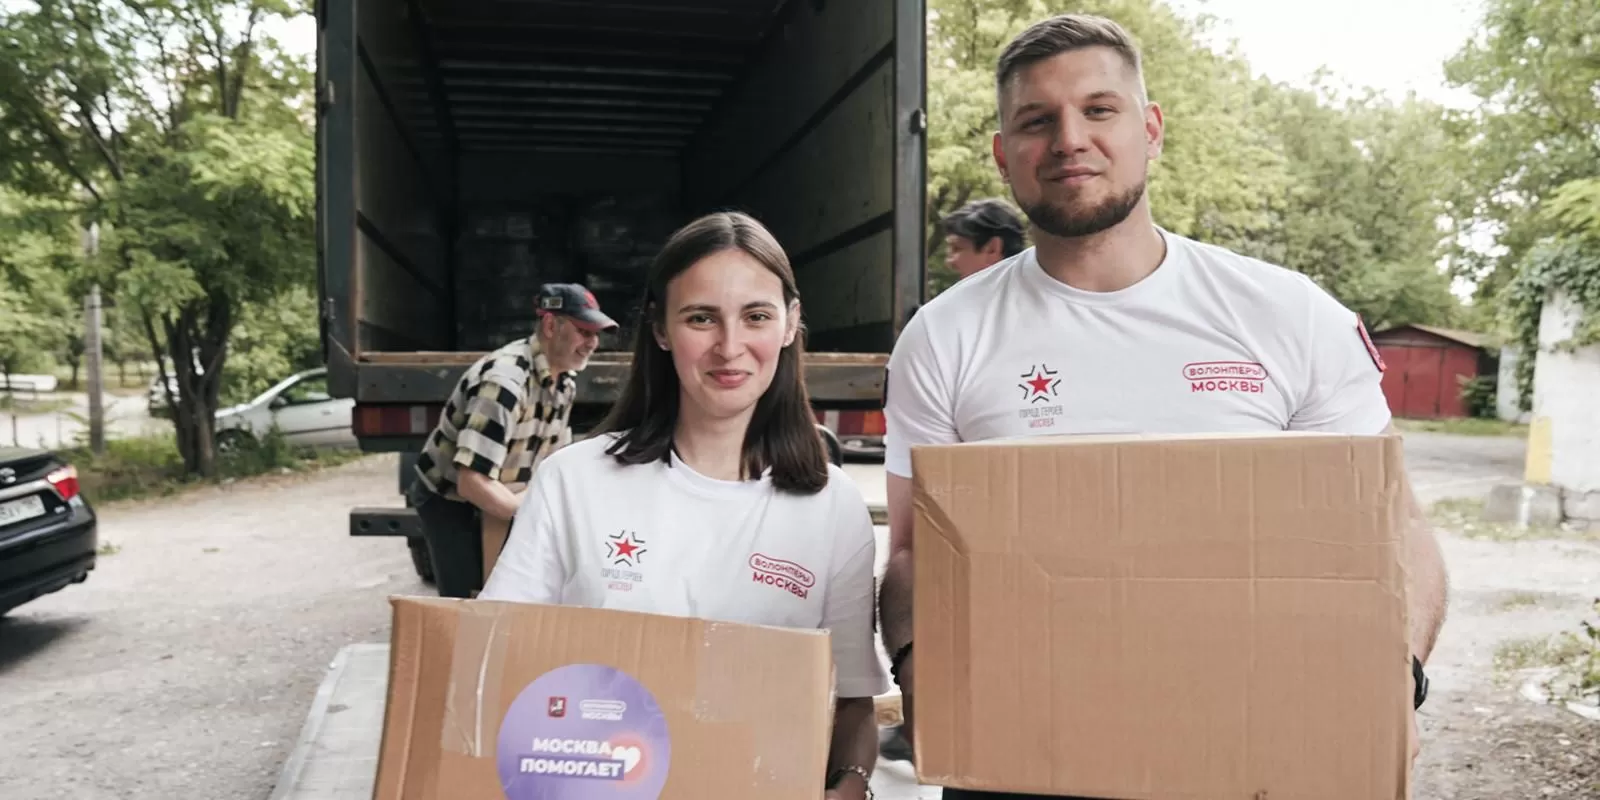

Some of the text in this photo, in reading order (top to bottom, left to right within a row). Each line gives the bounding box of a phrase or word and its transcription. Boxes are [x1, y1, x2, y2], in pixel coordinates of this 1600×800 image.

[1189, 366, 1262, 377] ВОЛОНТЕРЫ
[1191, 380, 1264, 393] МОСКВЫ
[752, 571, 808, 600] МОСКВЫ
[532, 737, 613, 755] МОСКВА
[520, 758, 622, 777] ПОМОГАЕТ
